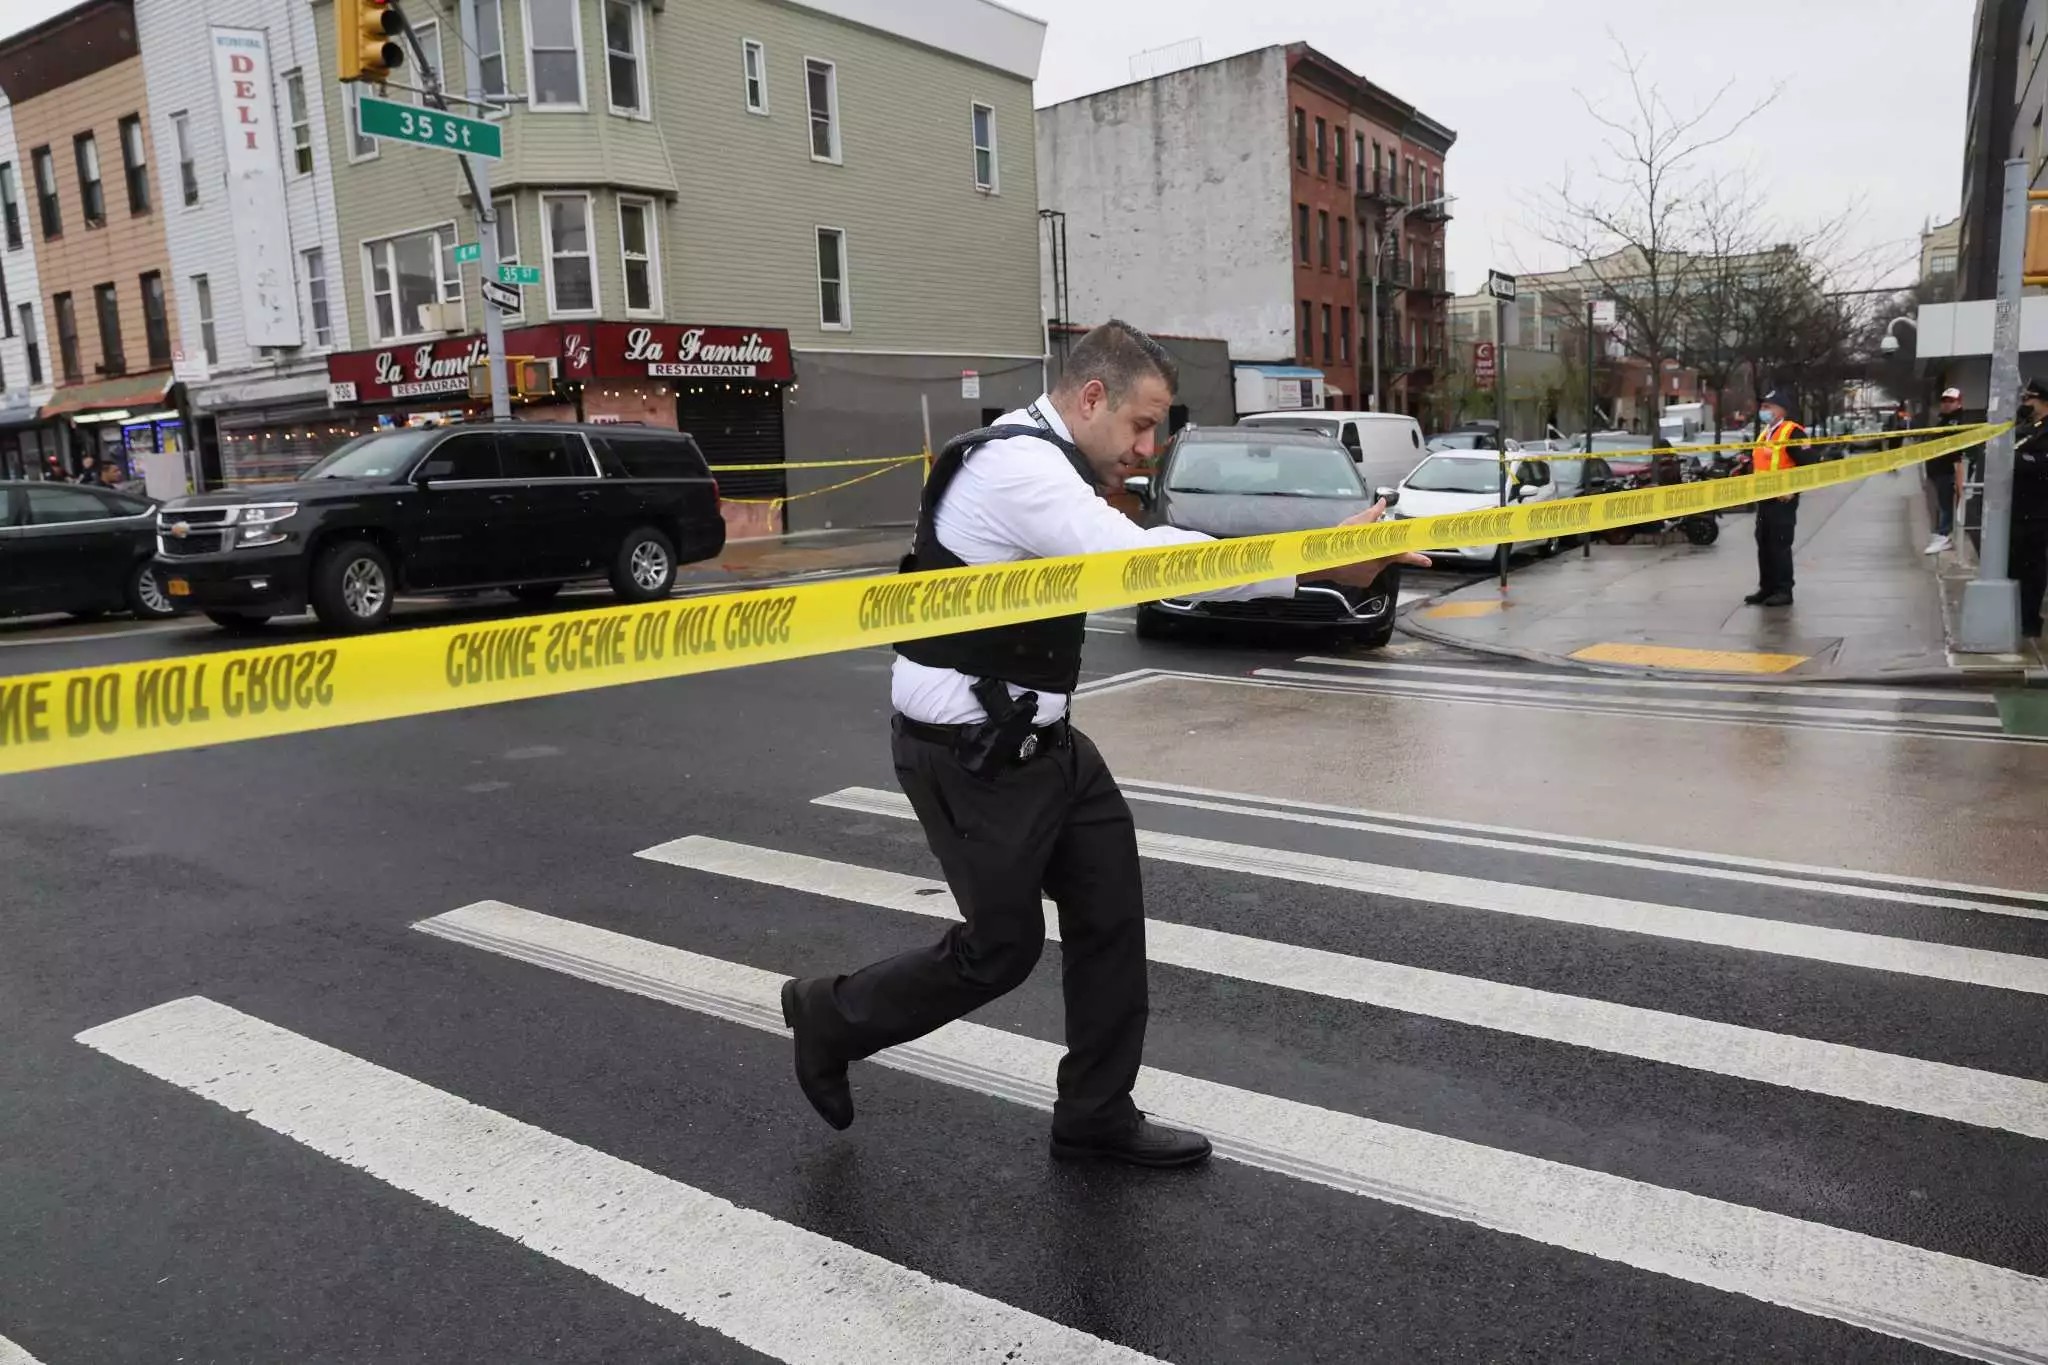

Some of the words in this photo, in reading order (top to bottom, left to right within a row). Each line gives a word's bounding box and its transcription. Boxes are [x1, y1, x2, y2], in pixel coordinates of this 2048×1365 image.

[229, 55, 259, 150] DELI
[400, 112, 433, 139] 35
[444, 121, 471, 147] St
[503, 268, 518, 282] 35
[375, 352, 403, 384] La
[415, 341, 487, 379] Famili
[625, 328, 663, 360] La
[679, 328, 773, 363] Familia
[397, 377, 468, 395] RESTAURAN
[655, 365, 750, 376] RESTAURANT
